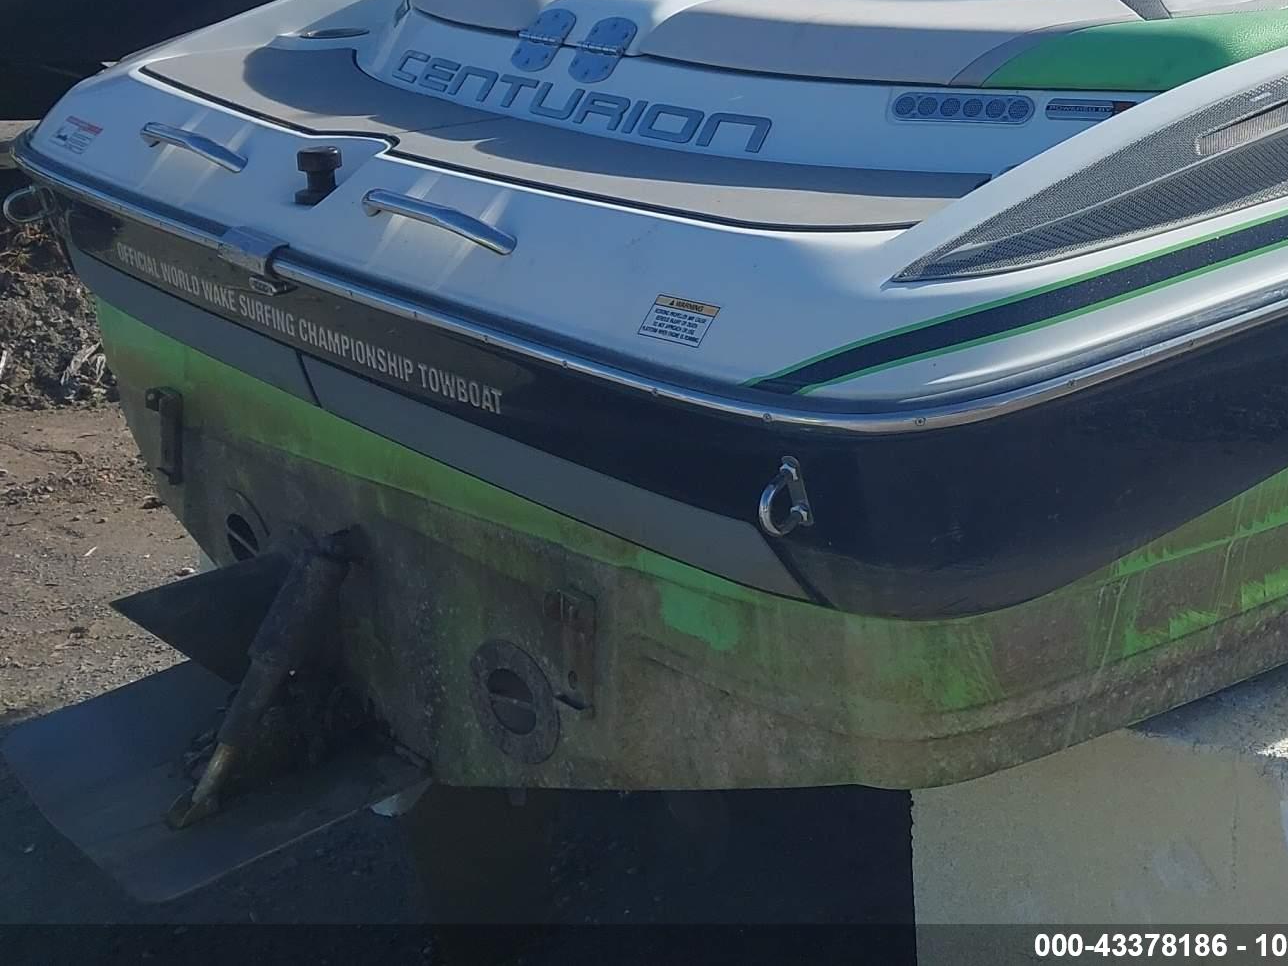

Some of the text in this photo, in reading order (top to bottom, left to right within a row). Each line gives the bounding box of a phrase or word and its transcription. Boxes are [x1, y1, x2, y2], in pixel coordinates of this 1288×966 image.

[391, 48, 773, 153] CENTURION
[116, 242, 502, 414] OFFICIAL WORLD WAKE SURFING CHAMPIONSHIP TOWBOAT
[676, 301, 704, 312] WARNING
